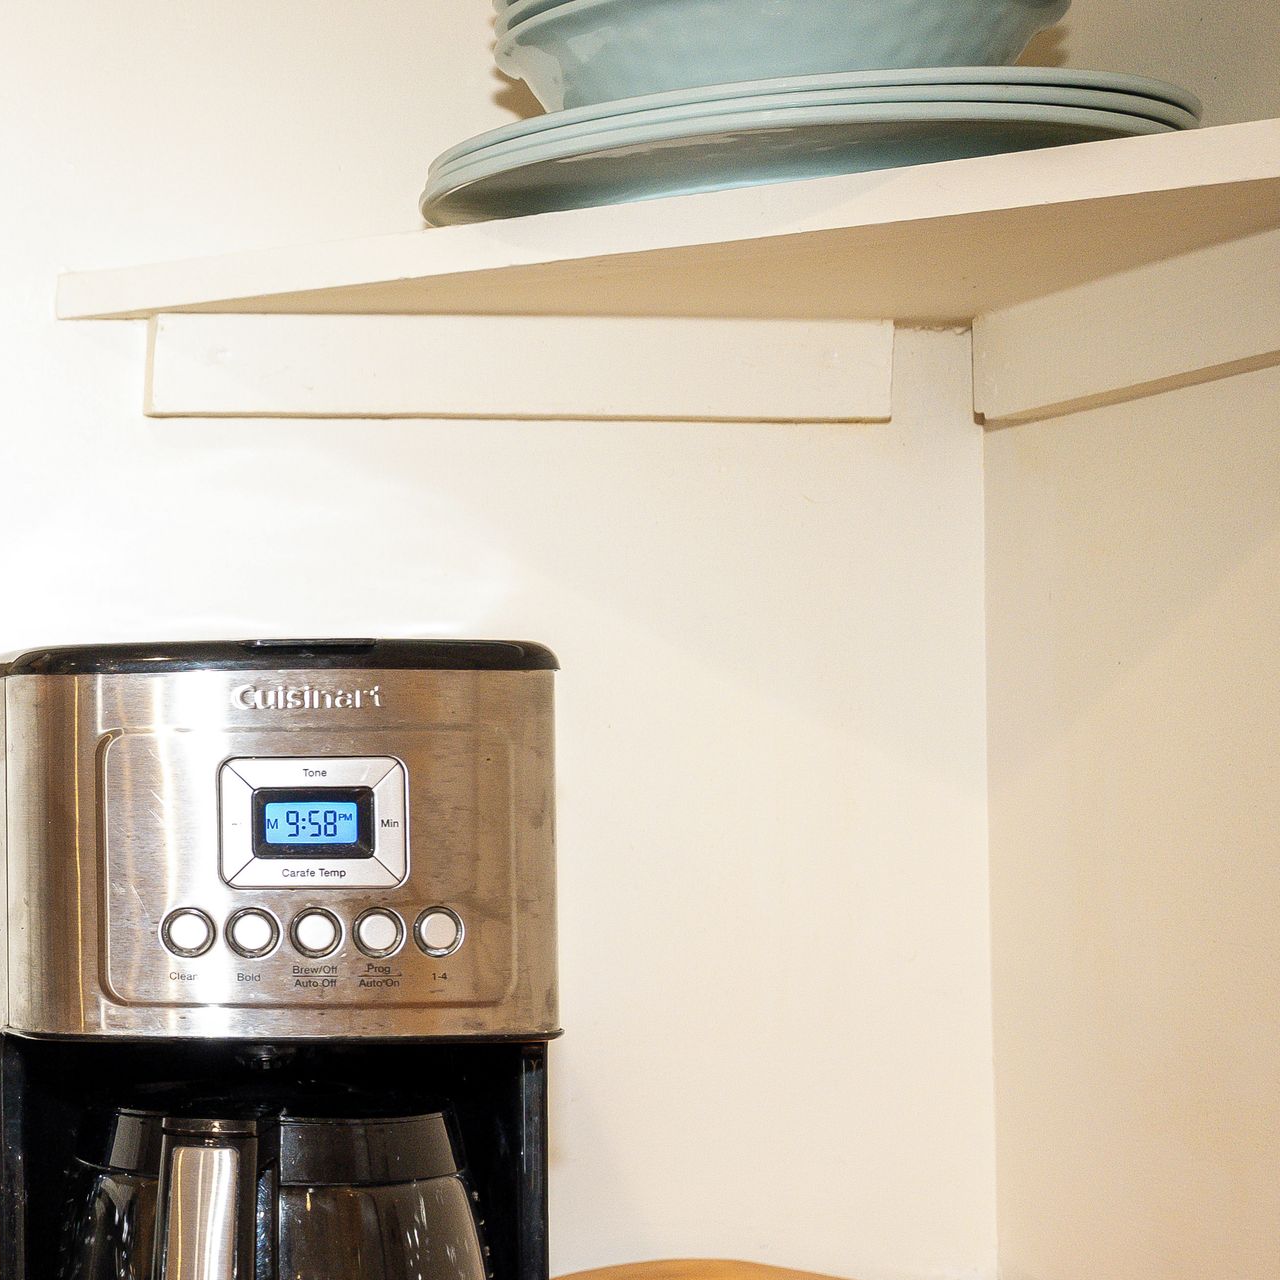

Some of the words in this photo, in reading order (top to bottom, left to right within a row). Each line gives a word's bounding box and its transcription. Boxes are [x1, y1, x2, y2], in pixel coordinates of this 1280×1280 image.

[231, 684, 384, 711] Cuisinart
[302, 768, 327, 777] Tone
[266, 818, 279, 830] M
[285, 810, 338, 837] 9:58
[338, 813, 353, 822] PM
[380, 819, 399, 828] Min
[281, 868, 316, 878] Carafe
[319, 868, 347, 881] Temp
[292, 965, 339, 975] Brew/Off
[366, 963, 391, 975] Prog
[169, 971, 198, 981] Clear
[236, 972, 261, 982] Bold
[431, 972, 448, 981] 1-4
[294, 978, 319, 988] Auto
[321, 978, 338, 988] Off
[358, 978, 383, 988] Auto
[384, 978, 400, 988] On
